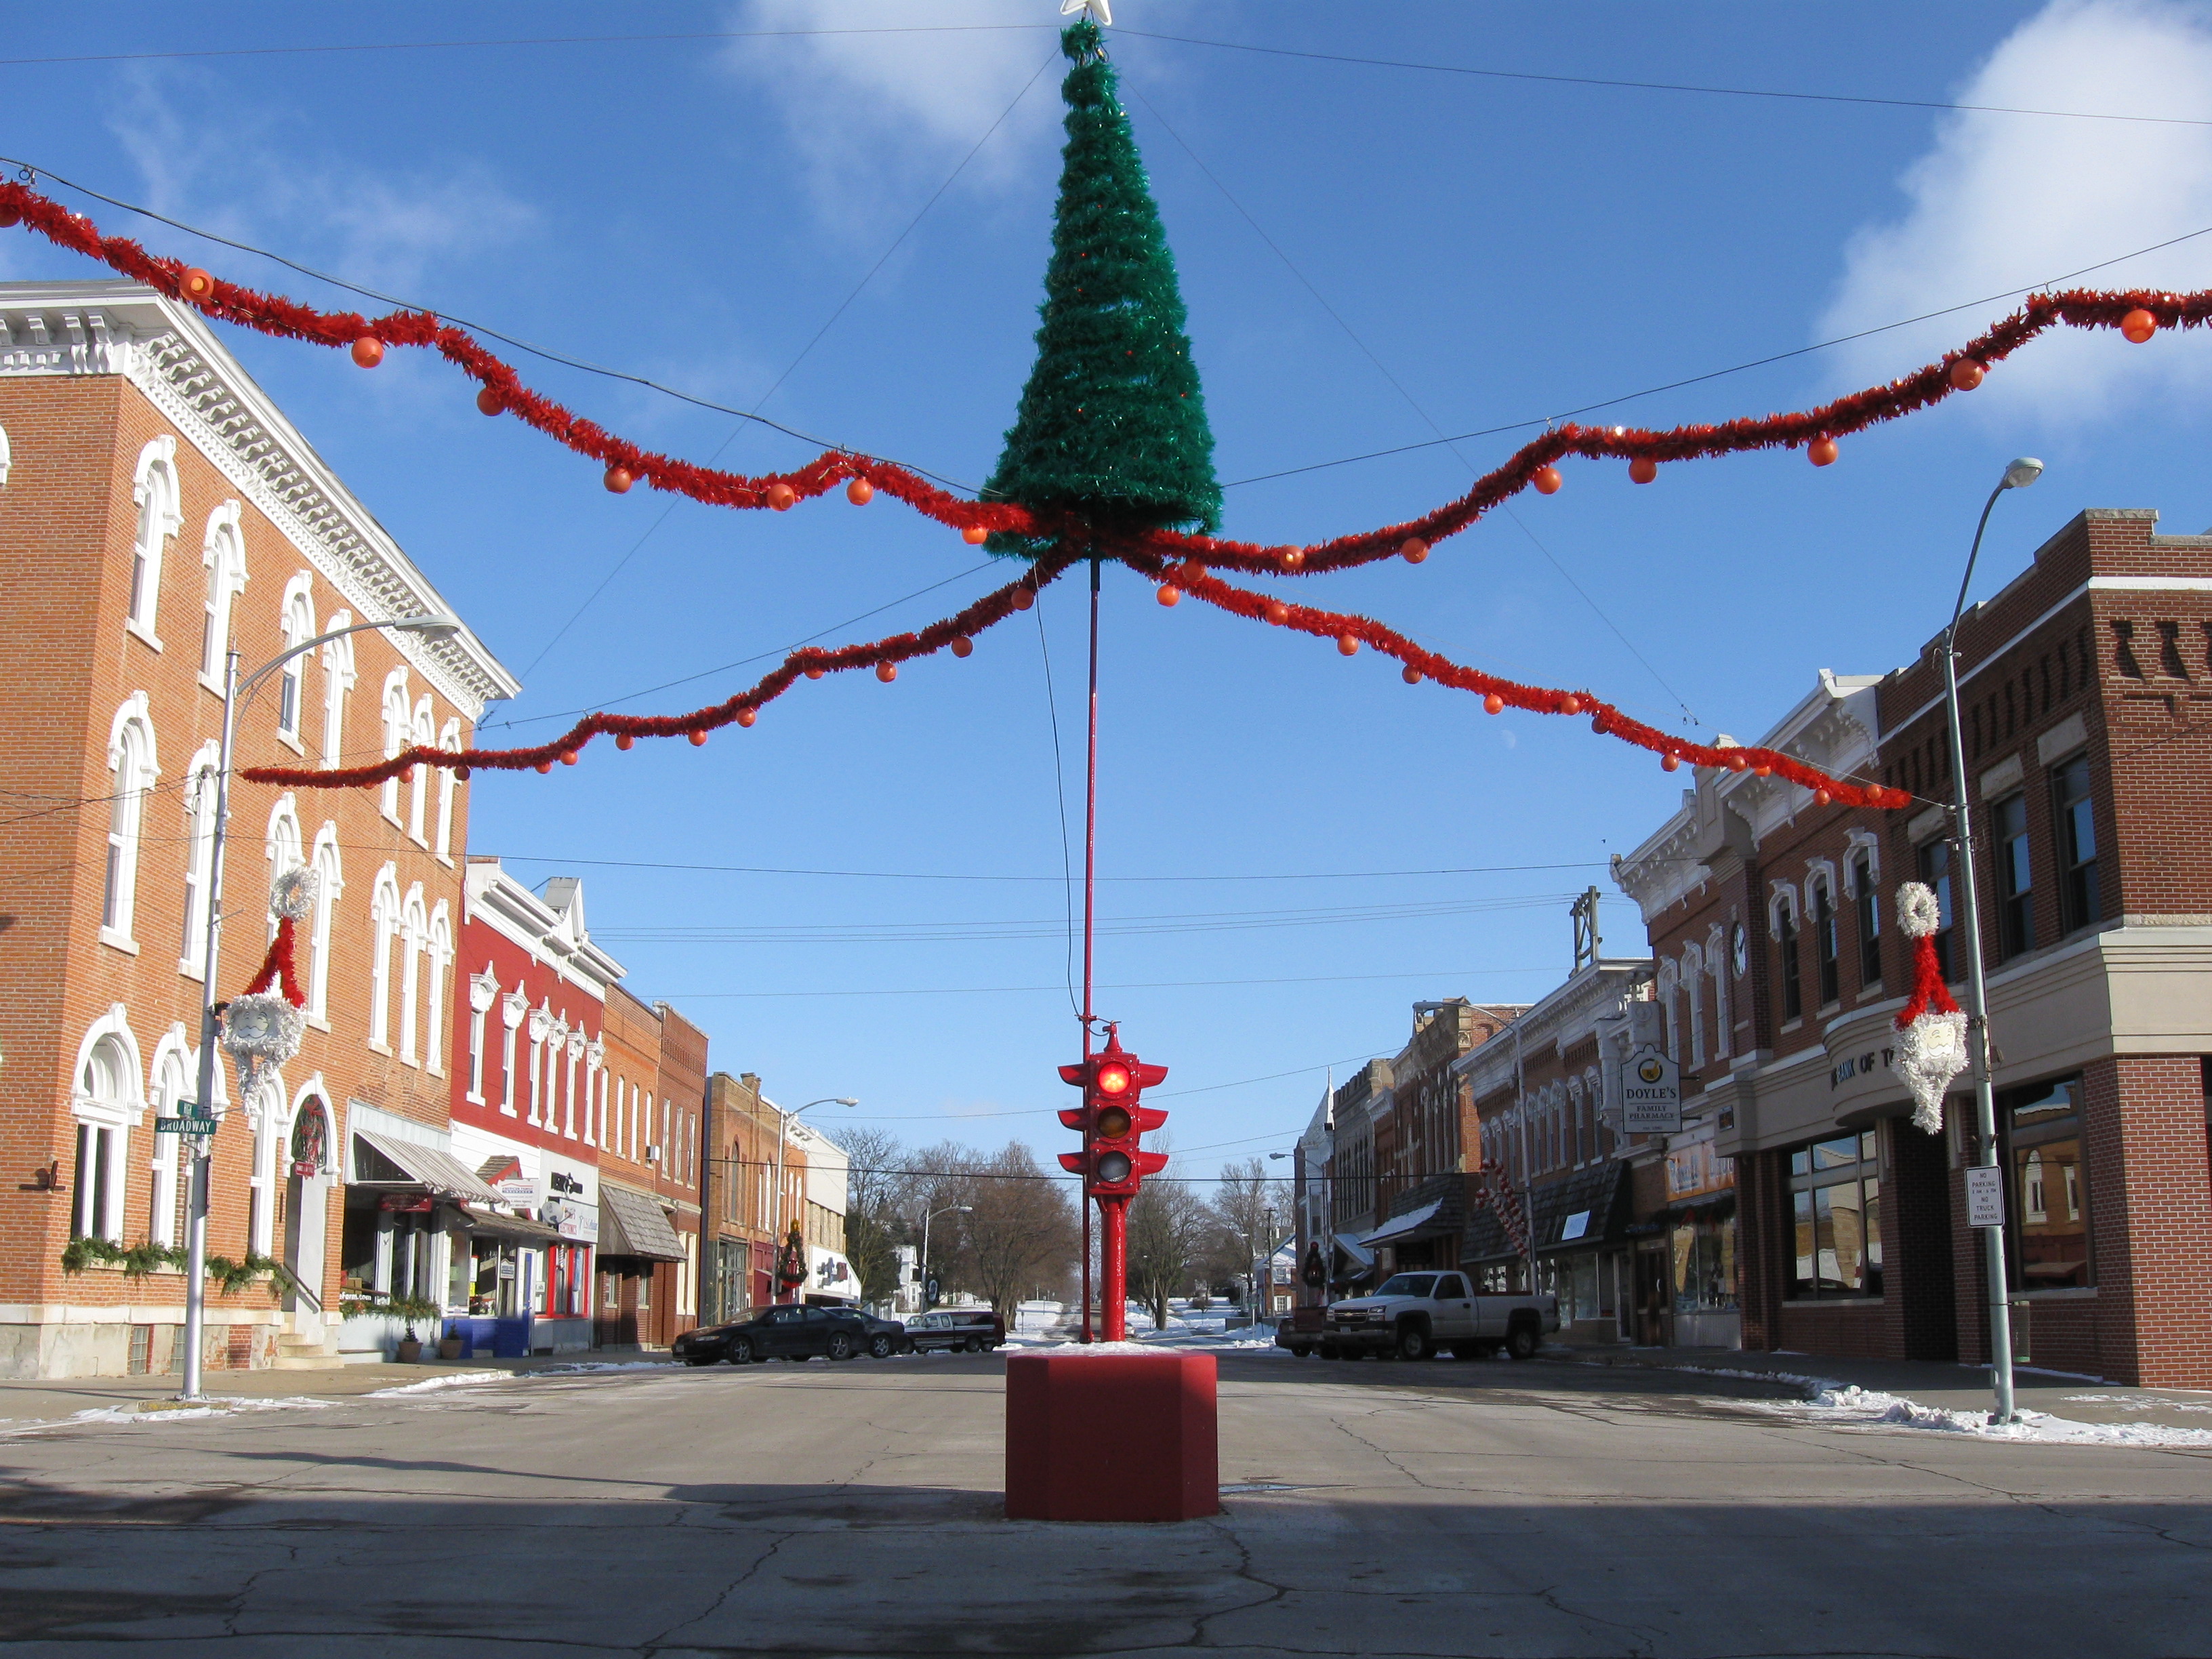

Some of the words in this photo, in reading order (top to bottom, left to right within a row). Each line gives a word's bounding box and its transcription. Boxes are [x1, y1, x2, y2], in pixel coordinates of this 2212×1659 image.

[1860, 1052, 1875, 1073] OF
[1626, 1086, 1676, 1099] DOYLE'S
[160, 1120, 212, 1132] BROADWAY
